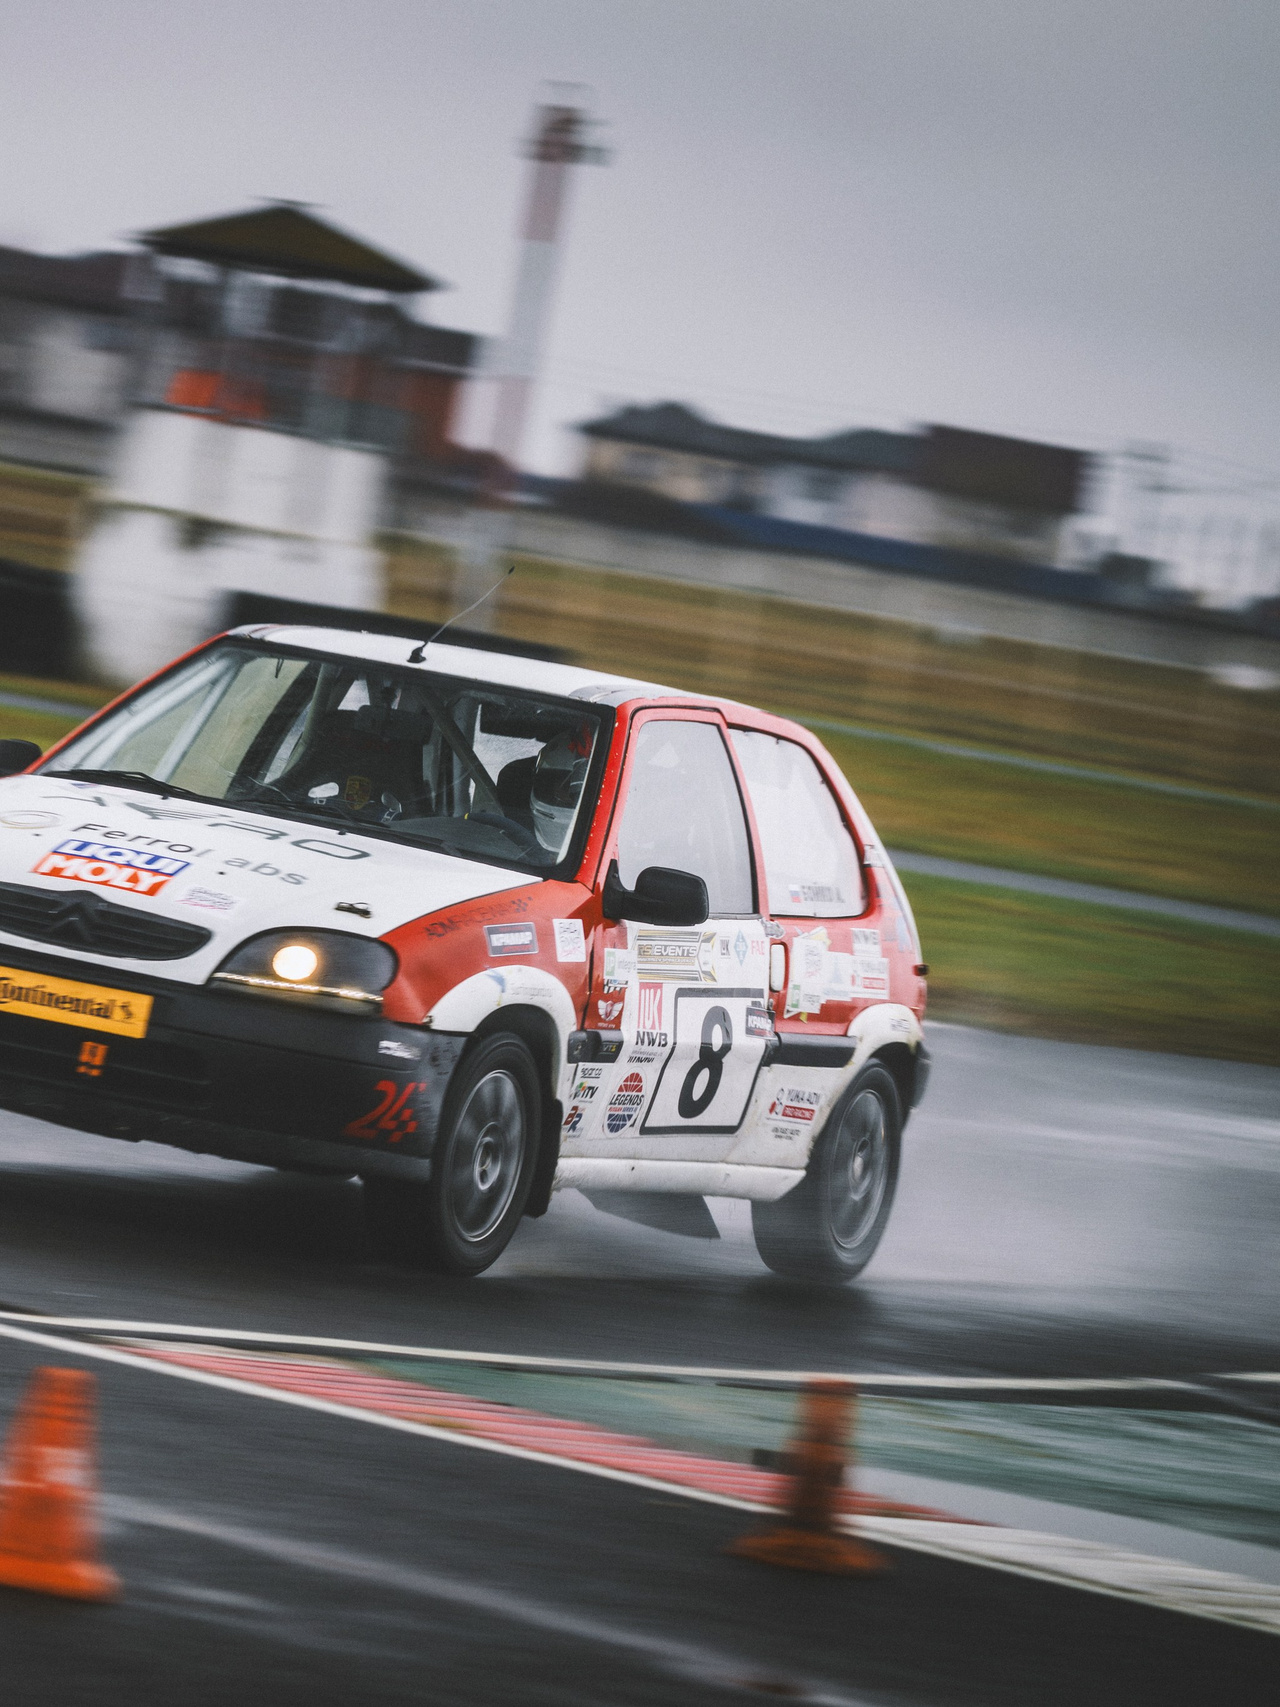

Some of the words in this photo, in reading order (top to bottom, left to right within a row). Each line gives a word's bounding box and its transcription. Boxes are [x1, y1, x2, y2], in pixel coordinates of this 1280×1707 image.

[61, 840, 186, 875] LIQUI
[42, 854, 169, 893] MOLY
[654, 945, 697, 957] EVENTS
[635, 1030, 668, 1047] NWB
[679, 1006, 733, 1119] 8
[609, 1094, 645, 1106] LEGENDS
